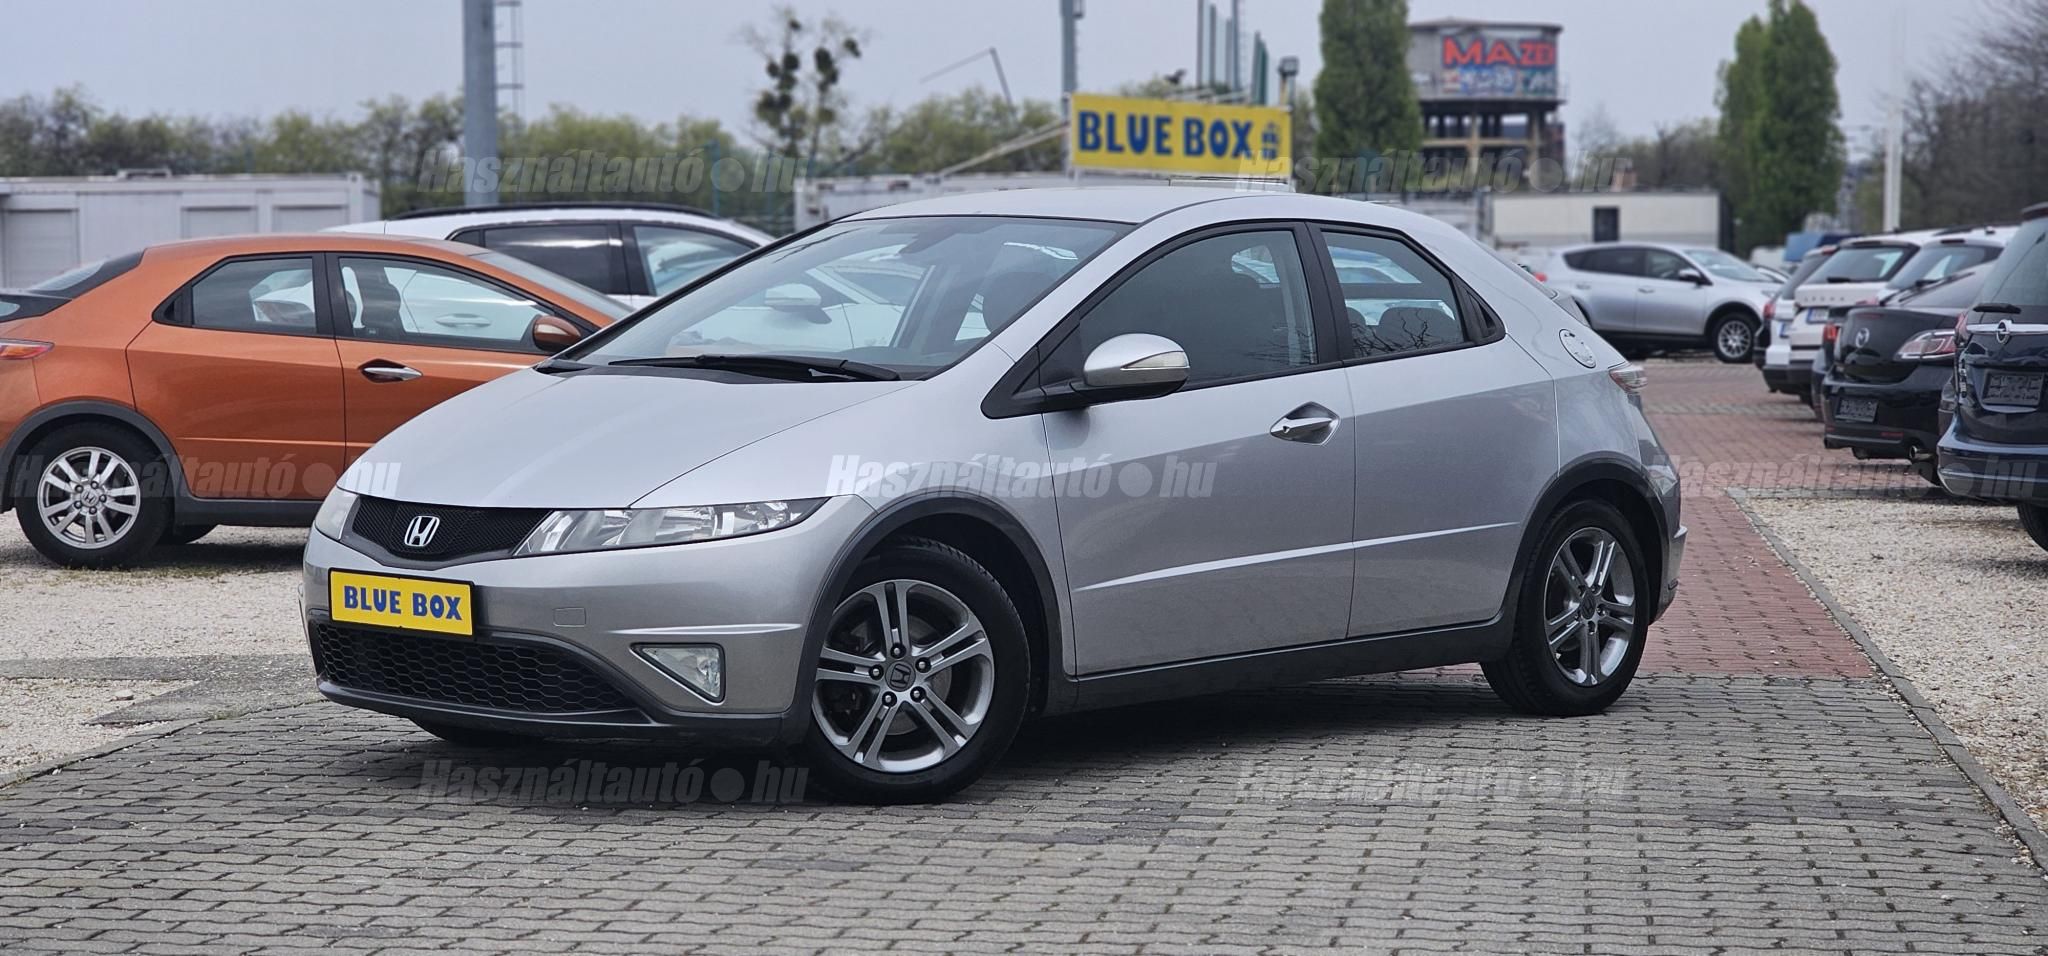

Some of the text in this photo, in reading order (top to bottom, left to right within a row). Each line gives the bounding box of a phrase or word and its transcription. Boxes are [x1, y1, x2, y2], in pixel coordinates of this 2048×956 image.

[1078, 111, 1254, 160] BLUE BOX
[344, 585, 462, 621] BLUE BOX
